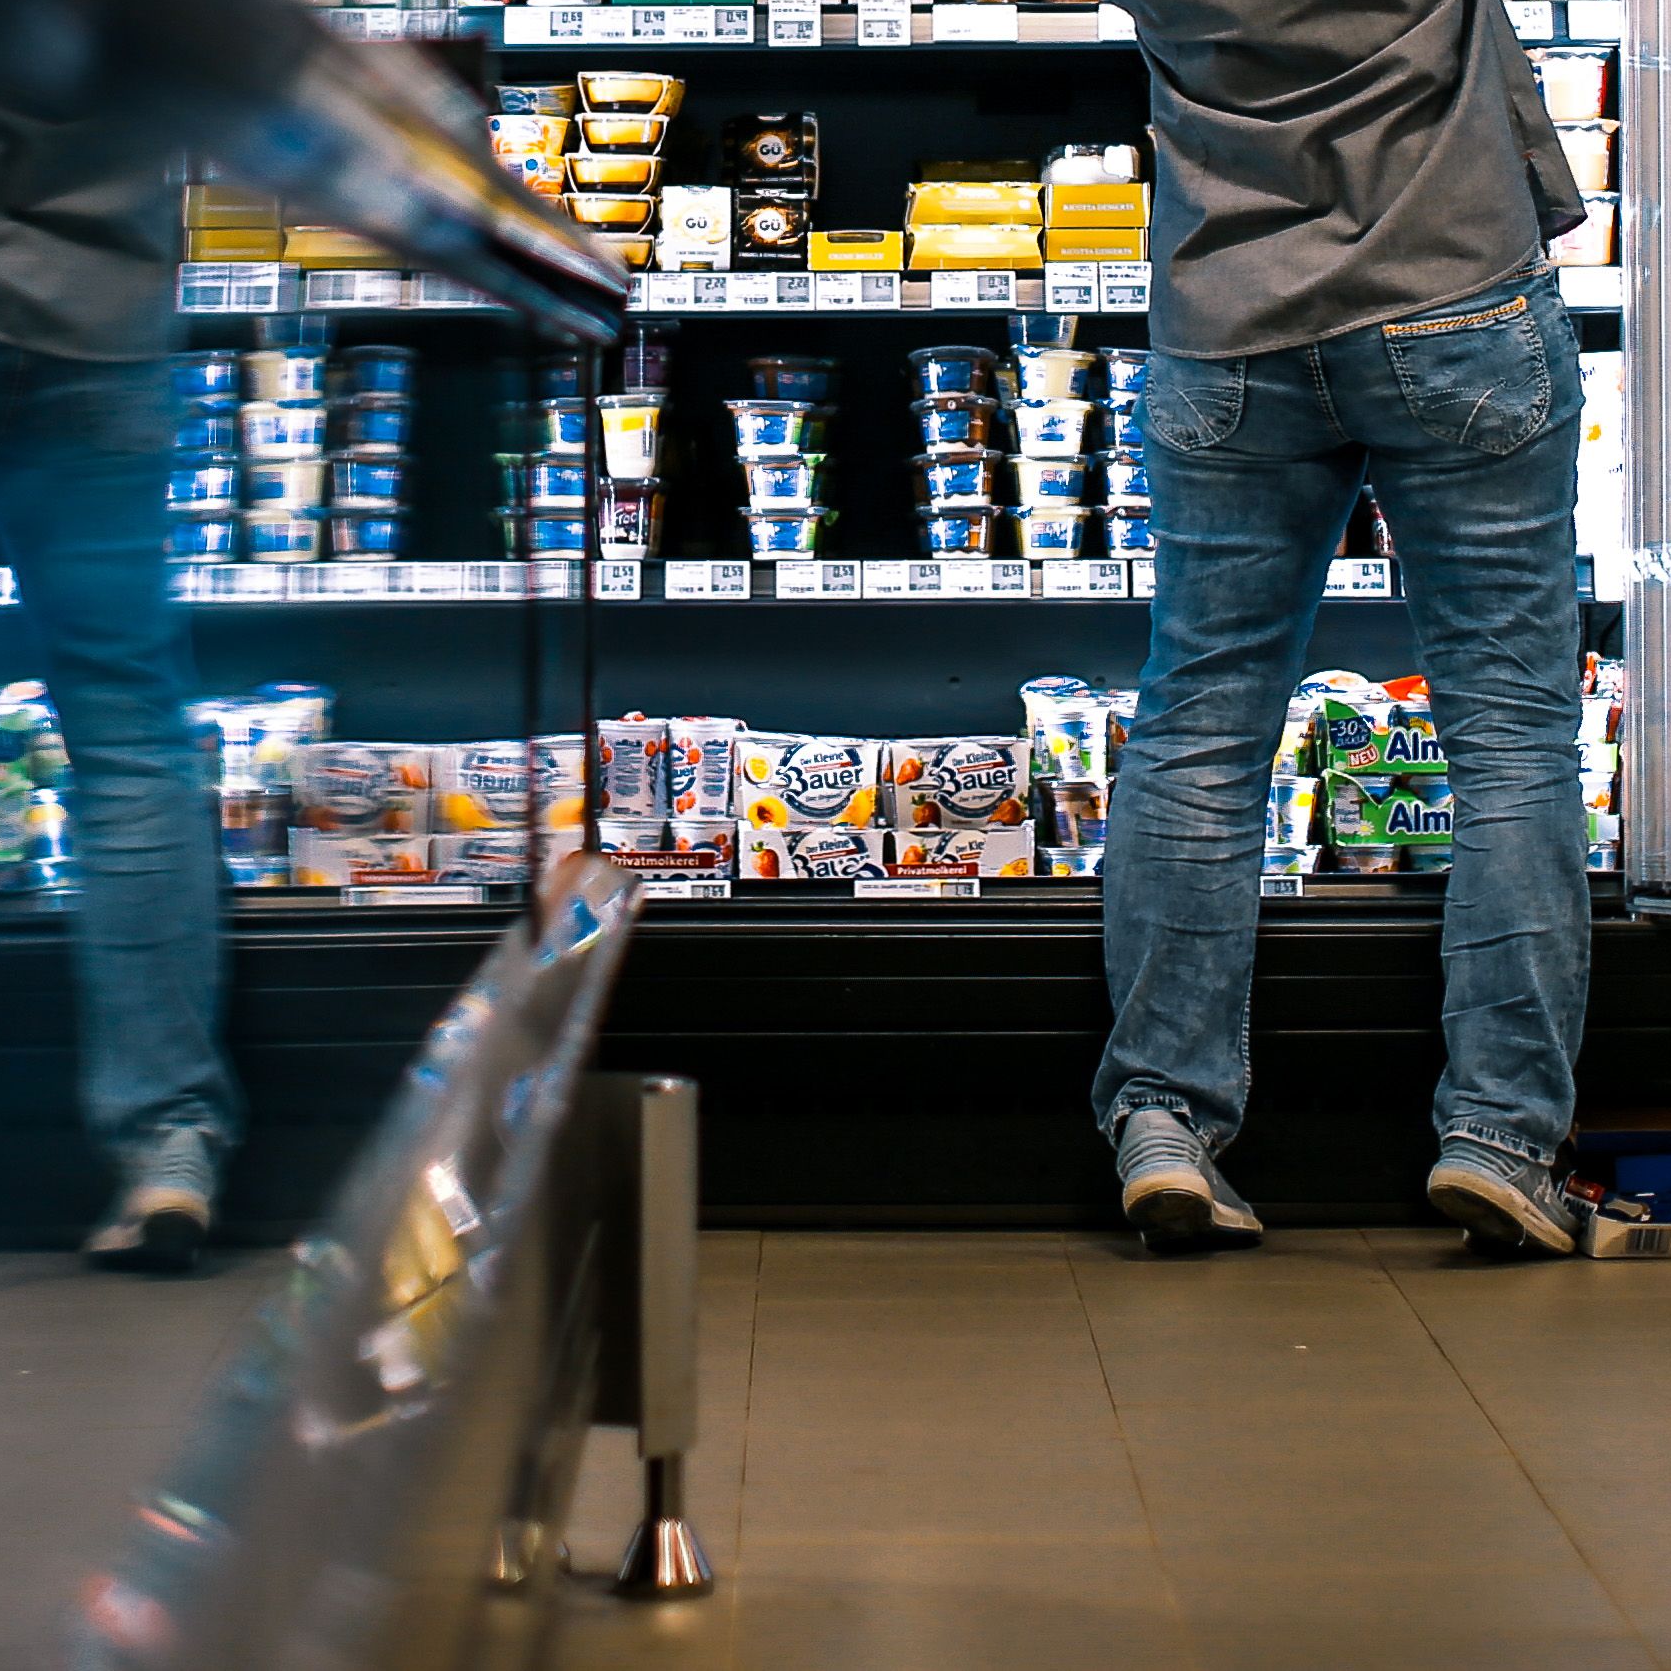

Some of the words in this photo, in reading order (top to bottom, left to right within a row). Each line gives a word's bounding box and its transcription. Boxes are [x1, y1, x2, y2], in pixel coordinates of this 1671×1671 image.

[561, 11, 583, 23] 0.69
[612, 565, 633, 578] 0.59
[722, 565, 743, 578] 0.59
[833, 565, 854, 578] 0.59
[919, 565, 940, 578] 0.59
[1002, 565, 1023, 578] 0.59
[1099, 565, 1120, 578] 0.59
[813, 751, 844, 763] Kleine
[966, 751, 997, 763] Kleine
[1349, 748, 1377, 764] NEU
[776, 766, 864, 798] Bauer
[929, 766, 1017, 797] Bauer
[1387, 802, 1451, 833] Alm
[819, 839, 851, 852] Kleine
[968, 839, 986, 850] Kle
[610, 855, 700, 867] Privatmolkerei
[897, 865, 968, 876] Privatmolkerei
